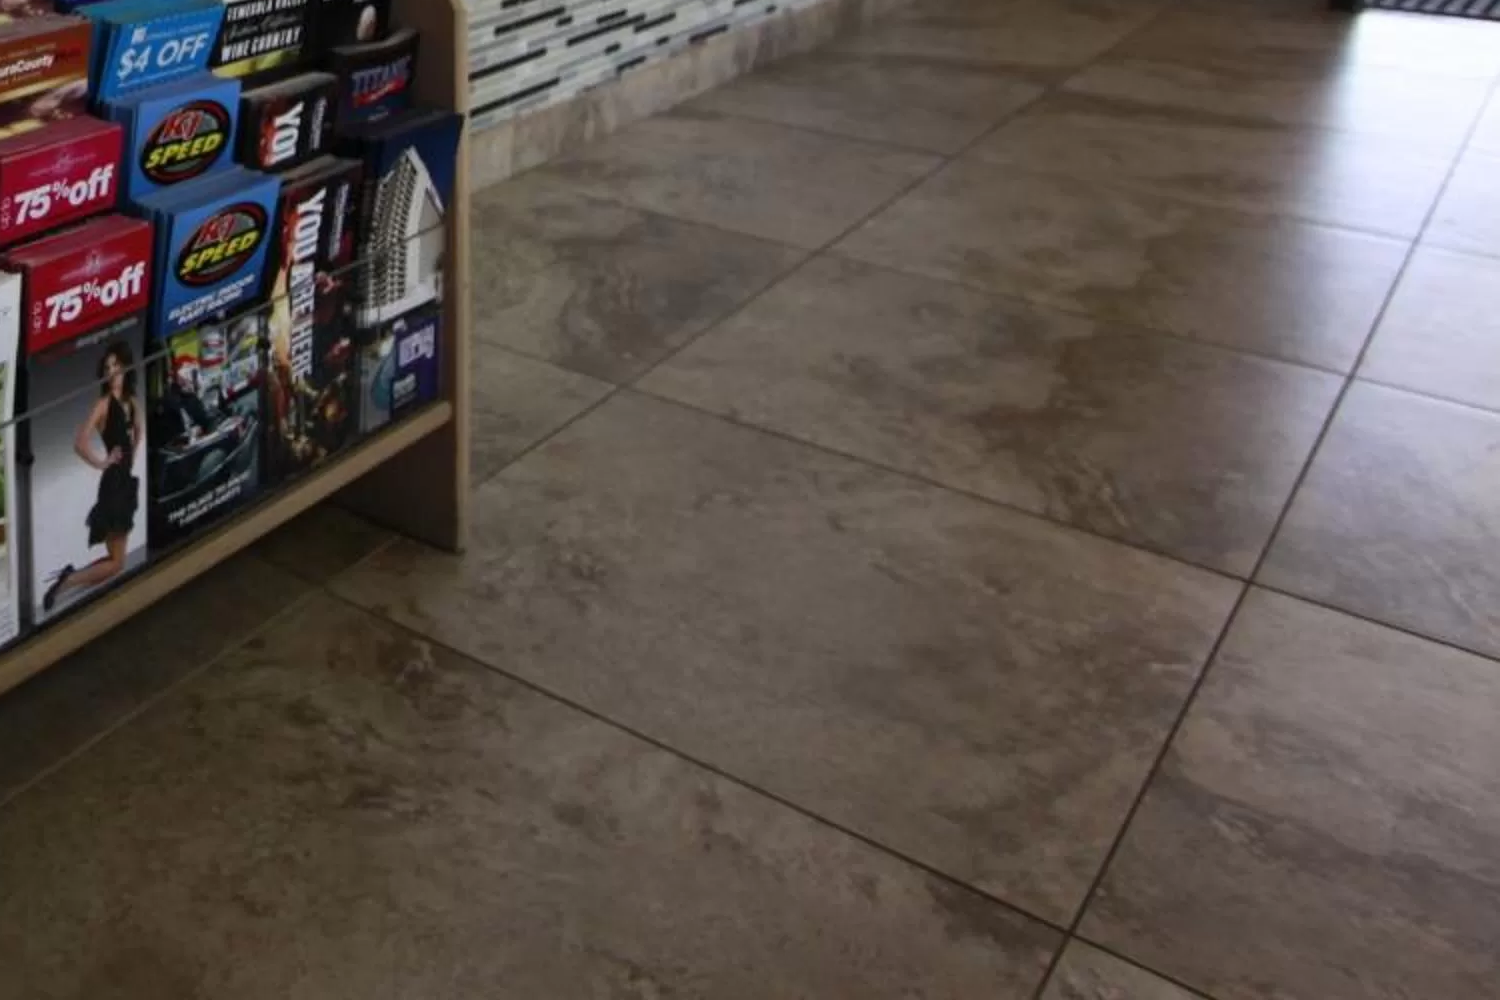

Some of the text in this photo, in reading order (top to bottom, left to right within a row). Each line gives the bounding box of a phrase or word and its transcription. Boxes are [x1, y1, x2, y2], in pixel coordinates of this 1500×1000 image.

[116, 32, 210, 83] $4 OFF
[251, 25, 304, 52] COUNTRY
[145, 131, 224, 170] SPEED
[13, 178, 70, 226] 75%
[67, 163, 116, 202] off
[293, 187, 327, 262] YOU
[179, 230, 260, 275] SPEED
[45, 277, 100, 329] 75%
[99, 260, 146, 307] off
[291, 262, 315, 313] ARE
